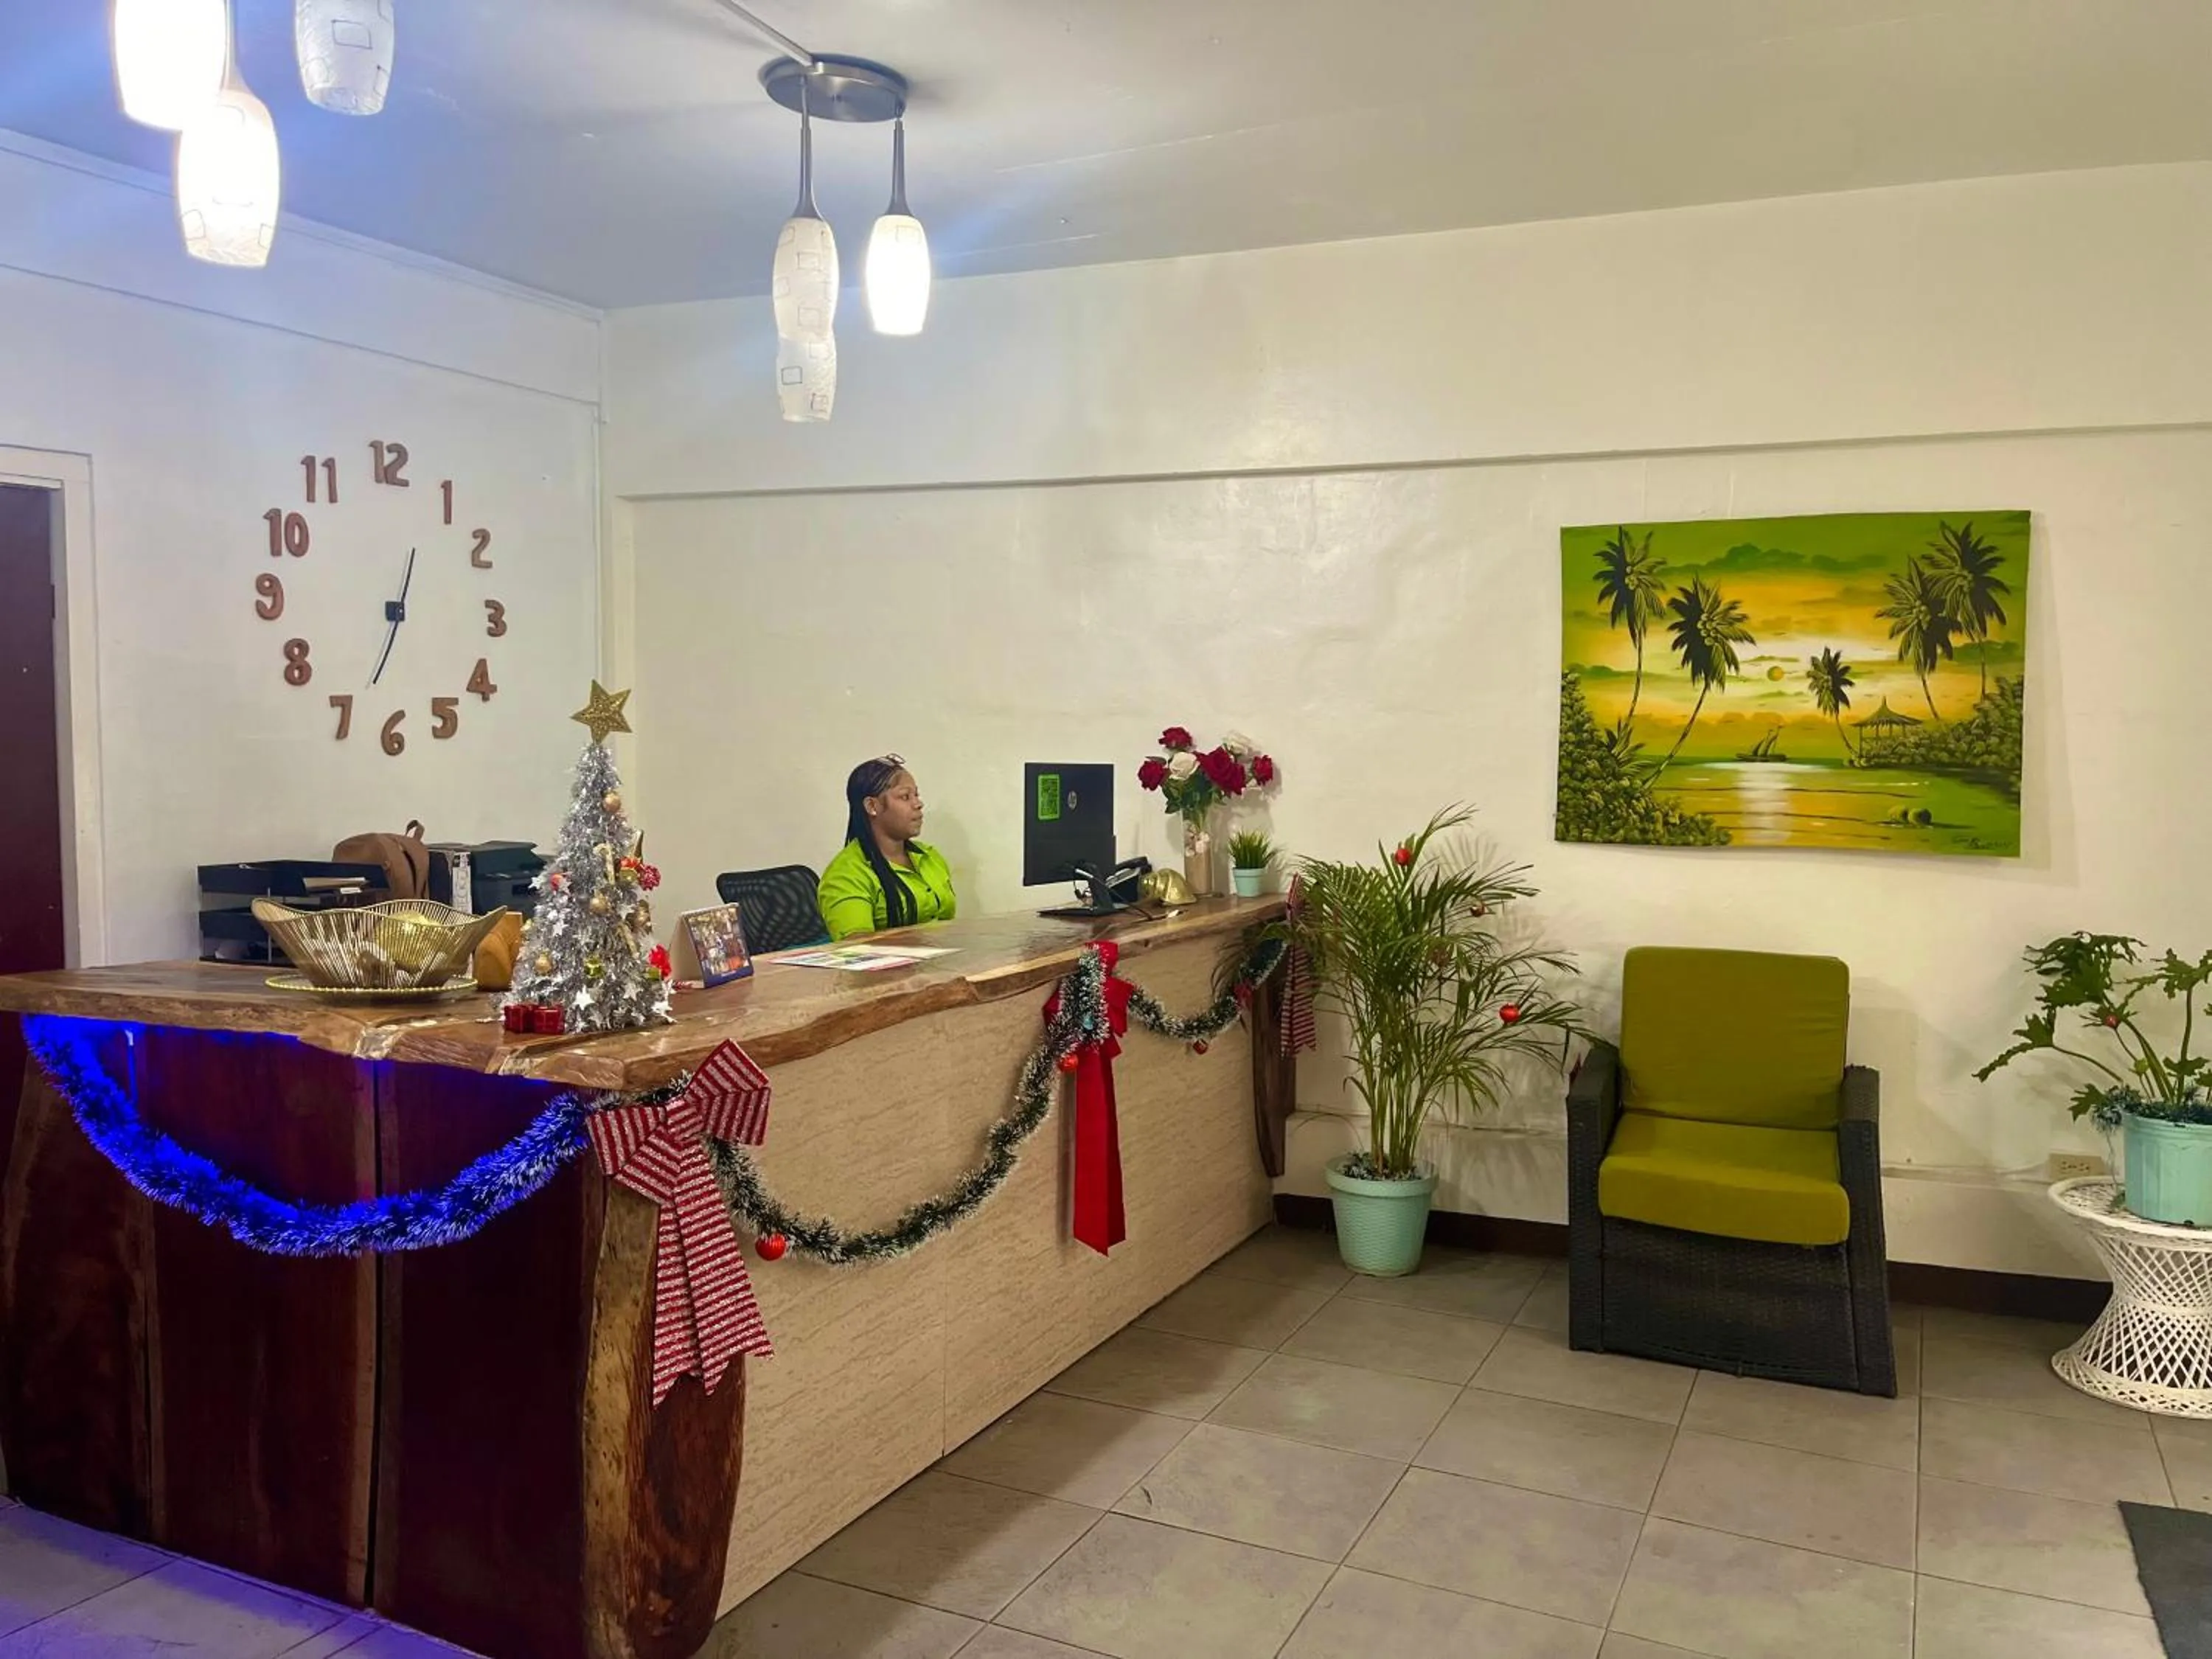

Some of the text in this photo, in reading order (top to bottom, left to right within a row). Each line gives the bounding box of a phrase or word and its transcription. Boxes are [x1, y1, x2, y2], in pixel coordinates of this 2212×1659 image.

[301, 455, 338, 503] 11
[369, 440, 409, 487] 12
[441, 480, 452, 524] 1
[263, 508, 309, 557] 10
[471, 529, 493, 568] 2
[255, 573, 284, 620] 9
[484, 599, 507, 637] 3
[284, 638, 312, 686] 8
[466, 658, 498, 701] 4
[329, 695, 353, 740] 7
[380, 709, 406, 756] 6
[431, 698, 459, 739] 5
